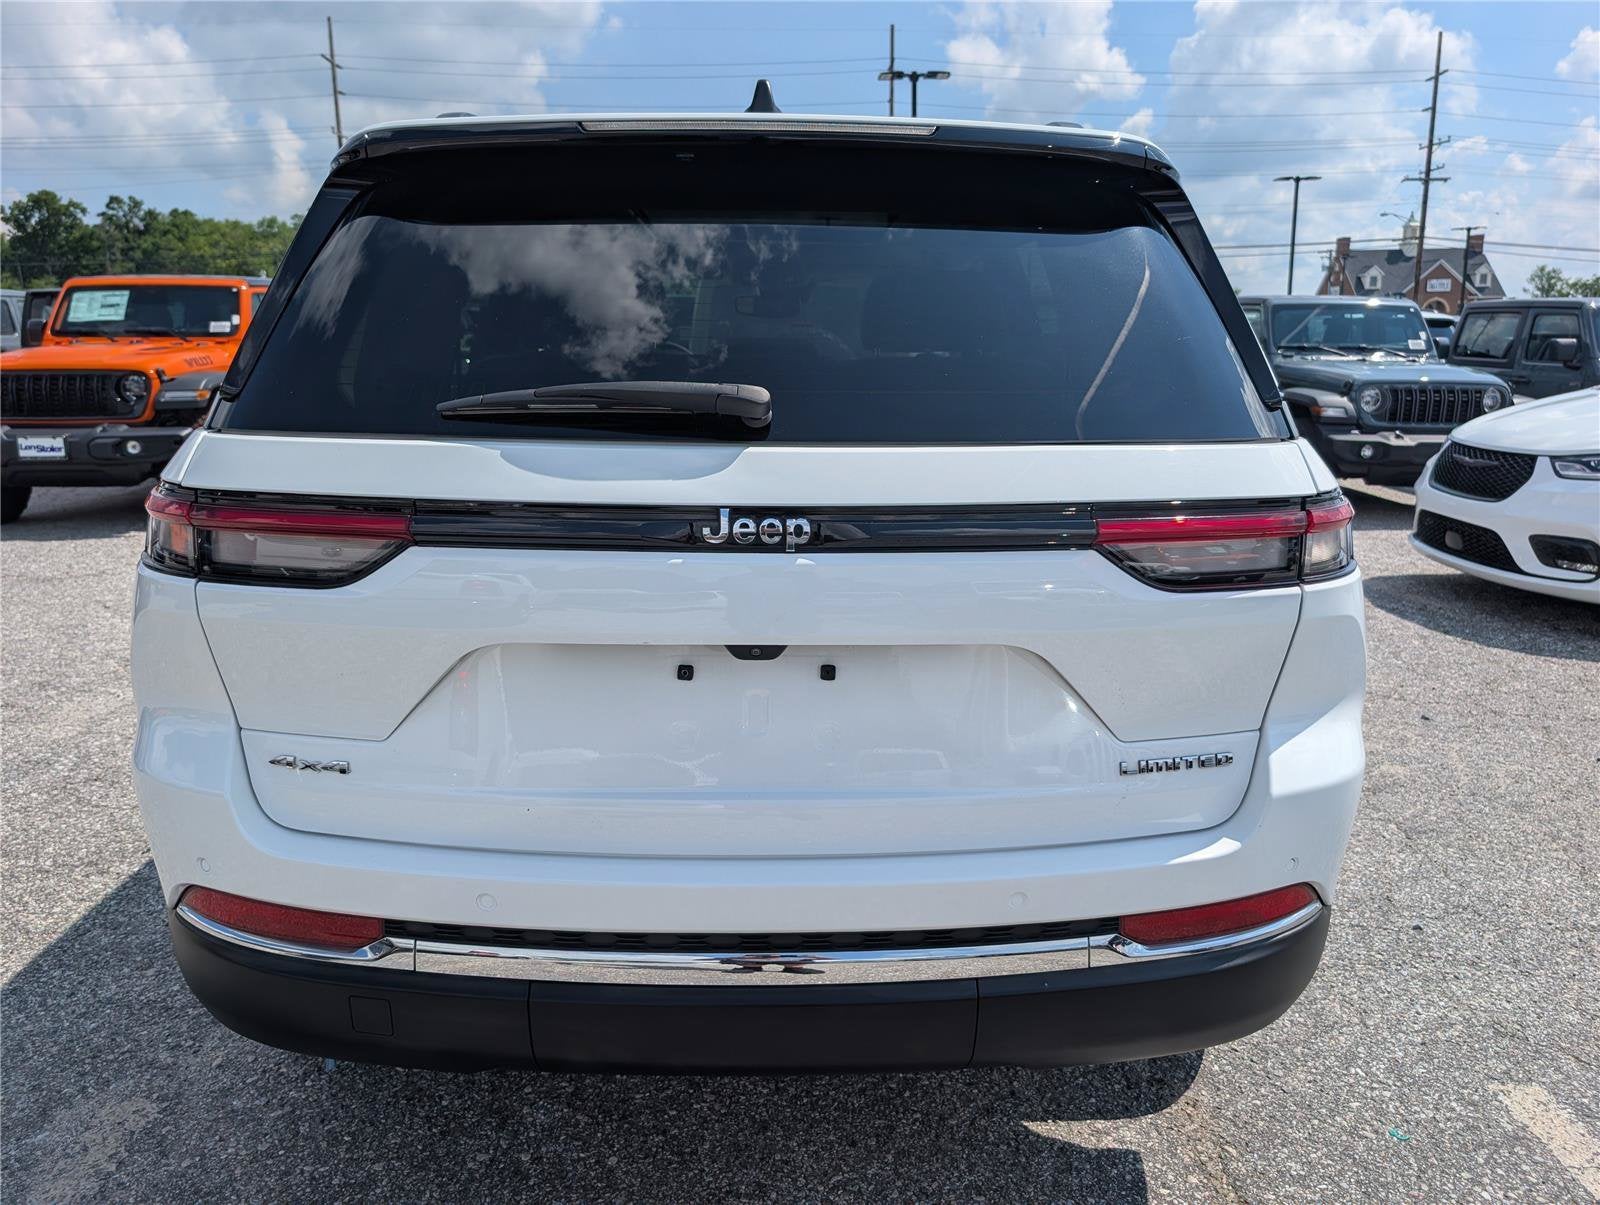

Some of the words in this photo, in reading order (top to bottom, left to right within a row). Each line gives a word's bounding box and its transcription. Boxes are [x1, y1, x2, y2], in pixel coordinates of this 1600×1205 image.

[702, 508, 811, 552] Jeep
[268, 754, 351, 775] 4x4
[1119, 752, 1233, 775] LIMITED
